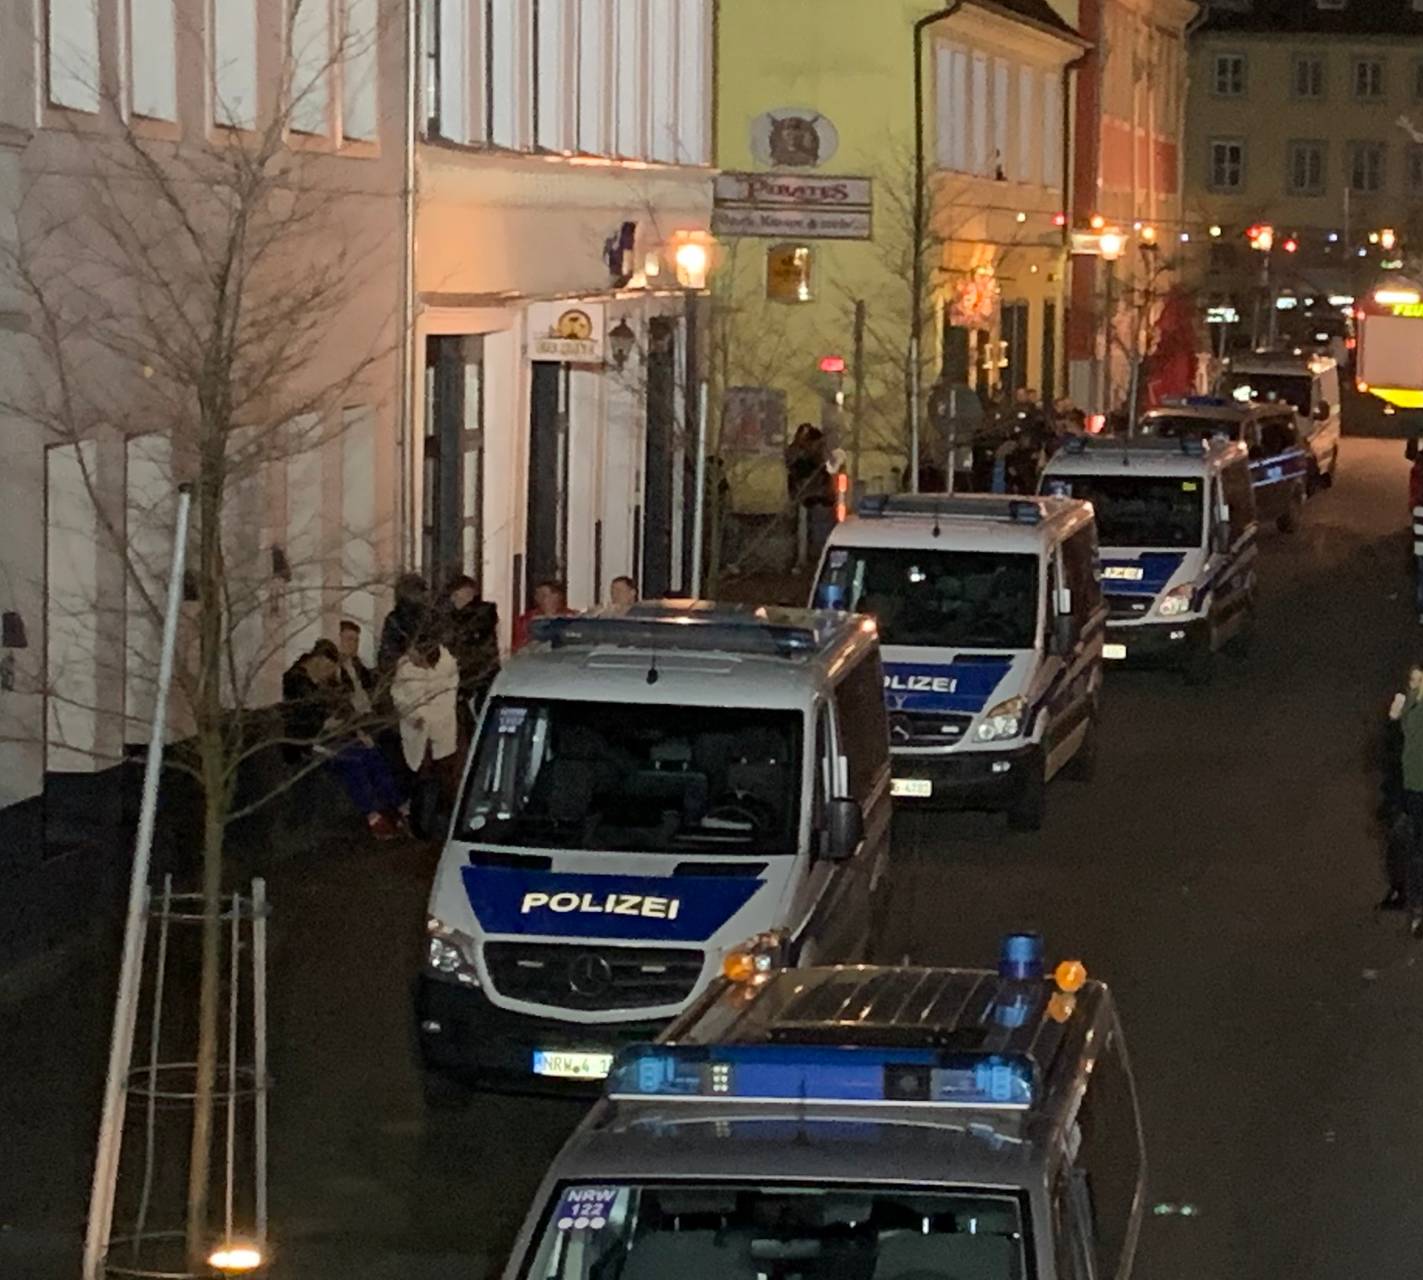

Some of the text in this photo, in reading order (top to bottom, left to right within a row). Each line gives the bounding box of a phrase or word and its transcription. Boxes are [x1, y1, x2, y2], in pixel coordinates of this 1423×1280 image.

[883, 675, 957, 693] LIZEI
[521, 892, 680, 920] POLIZEI
[543, 1056, 572, 1072] NRW
[567, 1189, 617, 1202] NRW
[571, 1203, 604, 1216] 122
